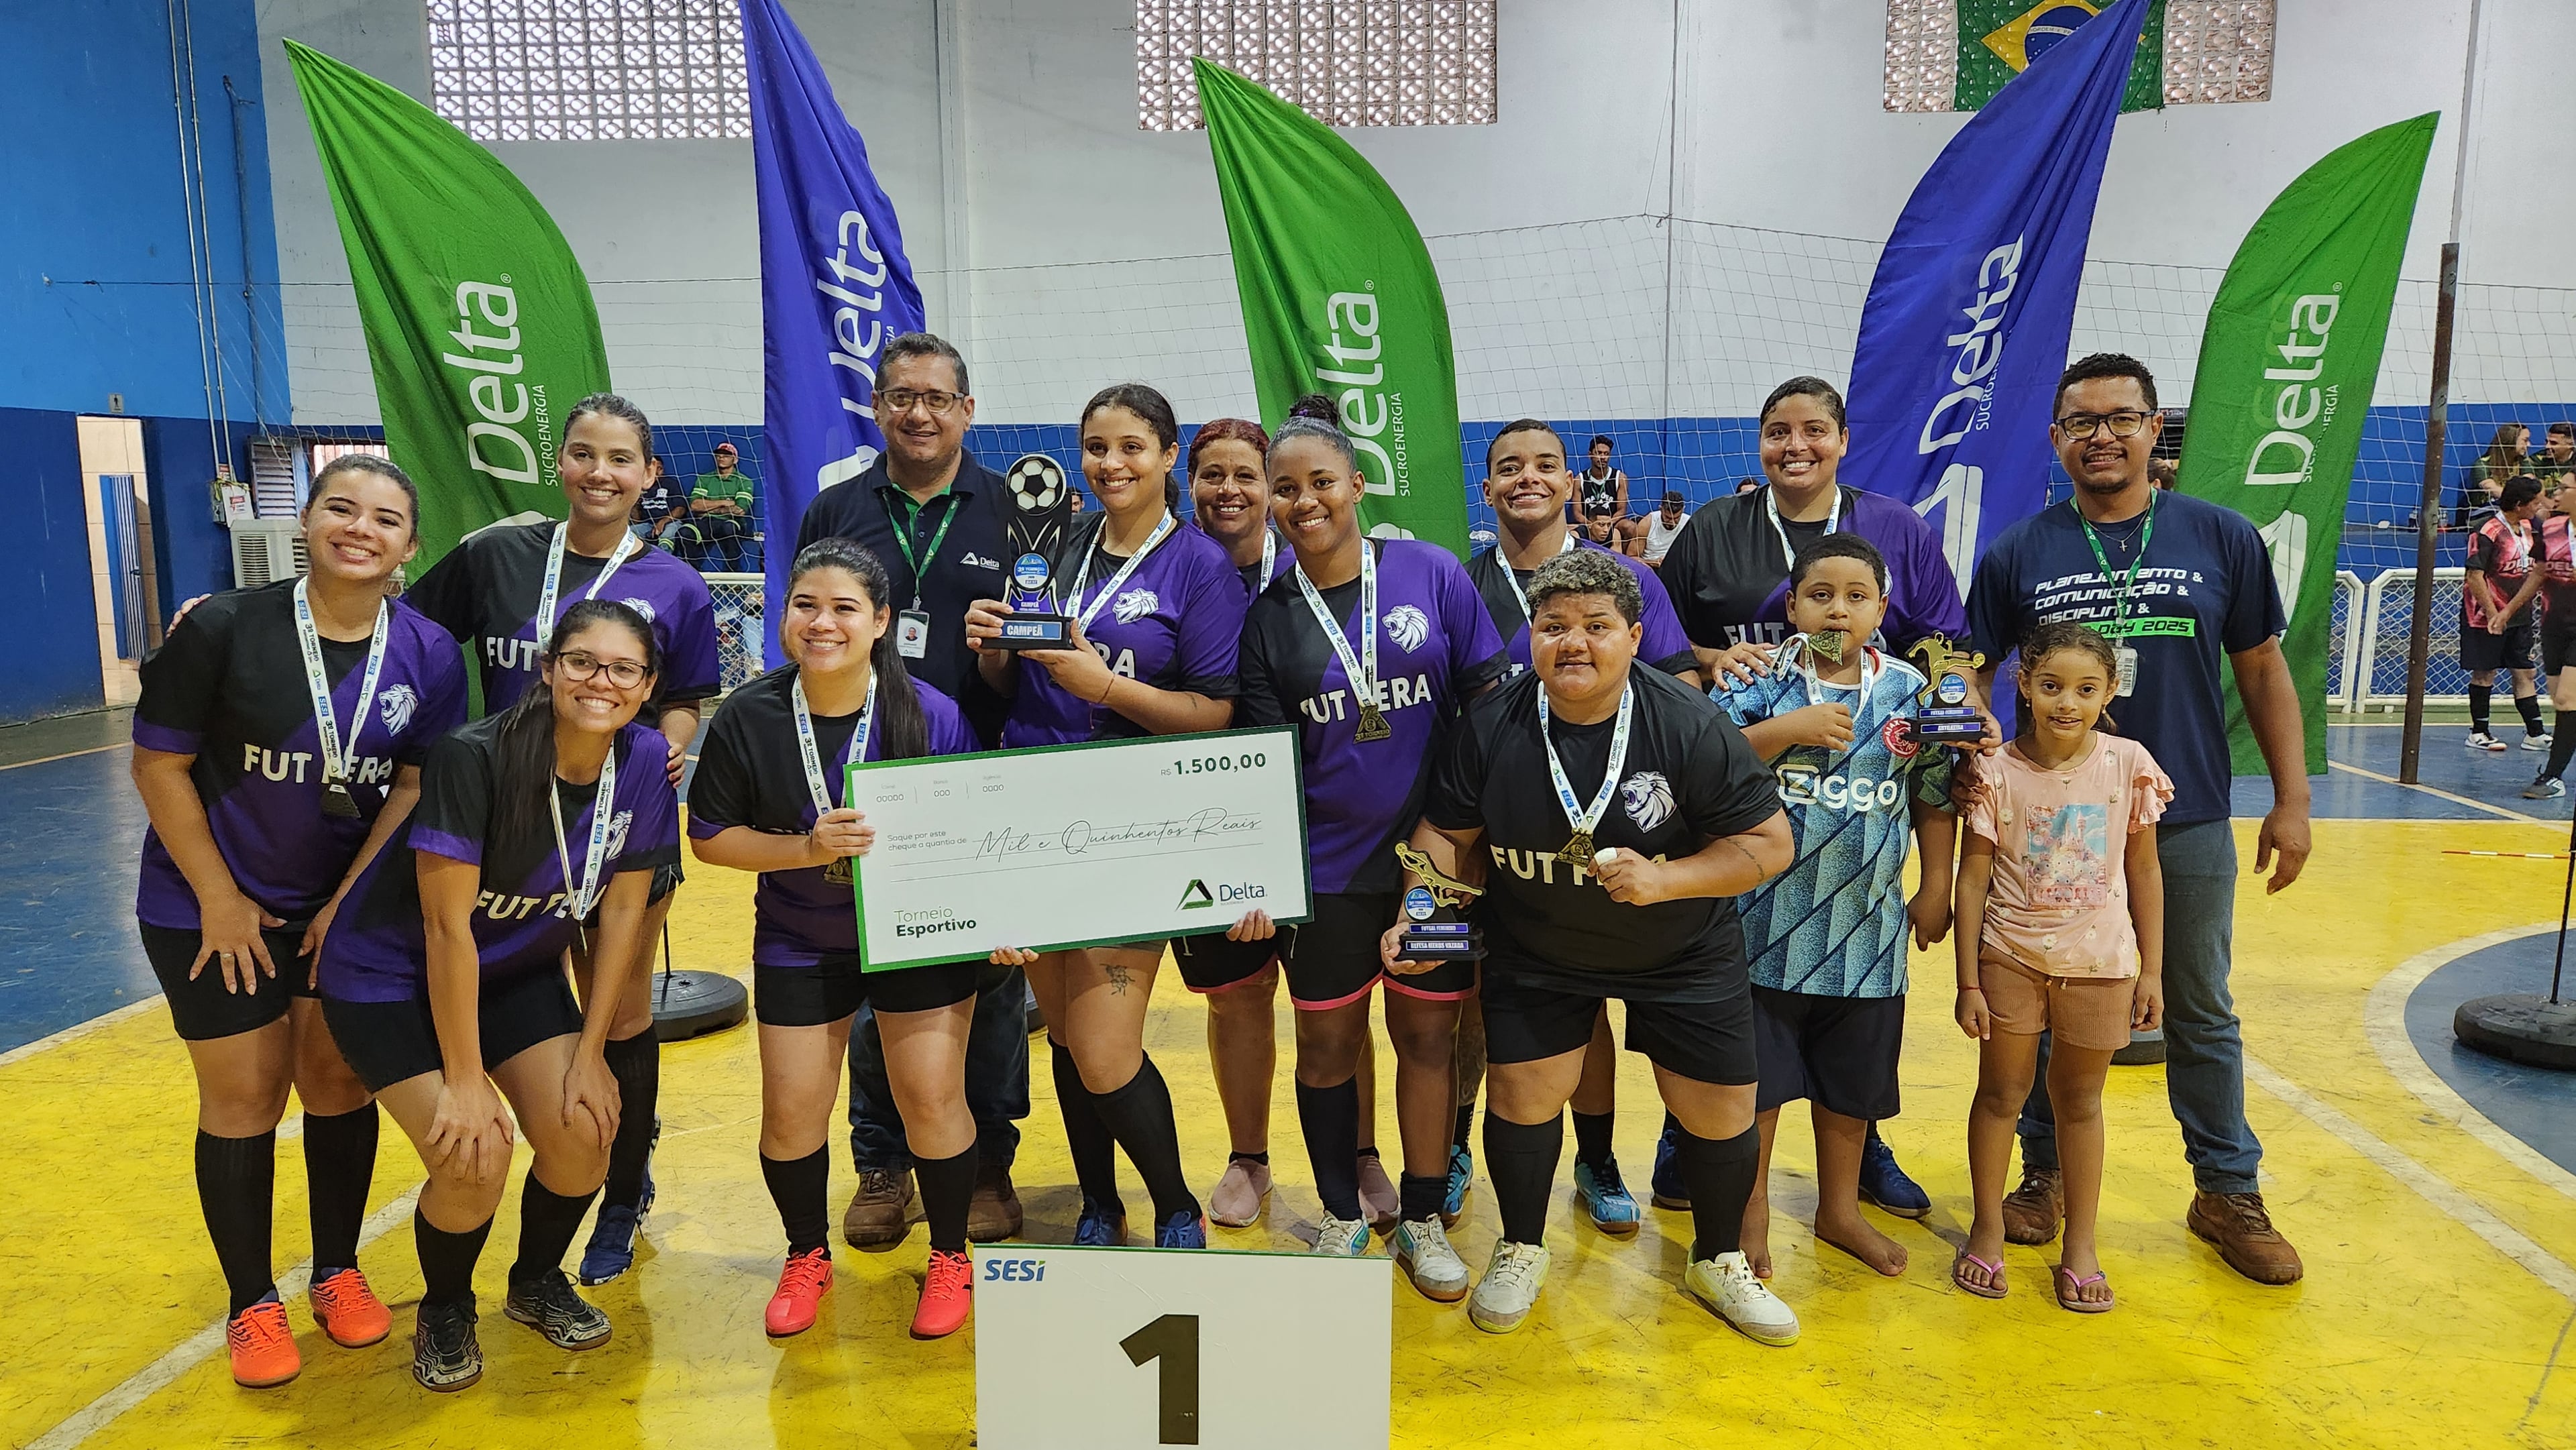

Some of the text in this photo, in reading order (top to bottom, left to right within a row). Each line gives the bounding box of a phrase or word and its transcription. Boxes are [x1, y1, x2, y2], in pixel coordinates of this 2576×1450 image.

[443, 280, 539, 484] Delta
[2245, 294, 2340, 485] Delta
[1316, 291, 1396, 496] Delta
[531, 384, 558, 487] SUCROENERGIA
[1390, 392, 1411, 496] SUCROENERGIA
[980, 557, 1000, 567] Delta
[2192, 572, 2203, 583] &
[2177, 585, 2189, 596] &
[2137, 603, 2150, 614] &
[1007, 624, 1042, 636] CAMPEÃ
[1326, 620, 1337, 634] SESI
[2142, 620, 2190, 633] 2025
[486, 637, 538, 672] FUT
[1342, 644, 1356, 669] TORNEIO
[319, 697, 328, 716] SESI
[799, 714, 808, 734] SESI
[858, 724, 866, 742] SESI
[1884, 719, 1901, 737] AJAX
[329, 731, 338, 758] TORNEIO
[244, 742, 313, 784] FUT
[808, 747, 818, 775] TORNEIO
[1174, 752, 1266, 775] 1.500,00
[598, 781, 607, 808] TORNEIO
[1600, 781, 1612, 799] SESI
[1776, 764, 1898, 812] Ziggo
[1562, 791, 1574, 807] SESI
[594, 825, 603, 843] SESI
[888, 834, 913, 842] Saque
[975, 807, 1262, 863] Mil e Quinhentos Reais
[888, 843, 917, 852] cheque
[925, 838, 955, 848] quantia
[1490, 844, 1557, 884] FUT
[1220, 882, 1265, 901] Delta
[471, 889, 541, 919] FUT
[894, 906, 953, 923] Torneio
[896, 918, 977, 938] Esportivo
[1118, 1313, 1199, 1445] 1
